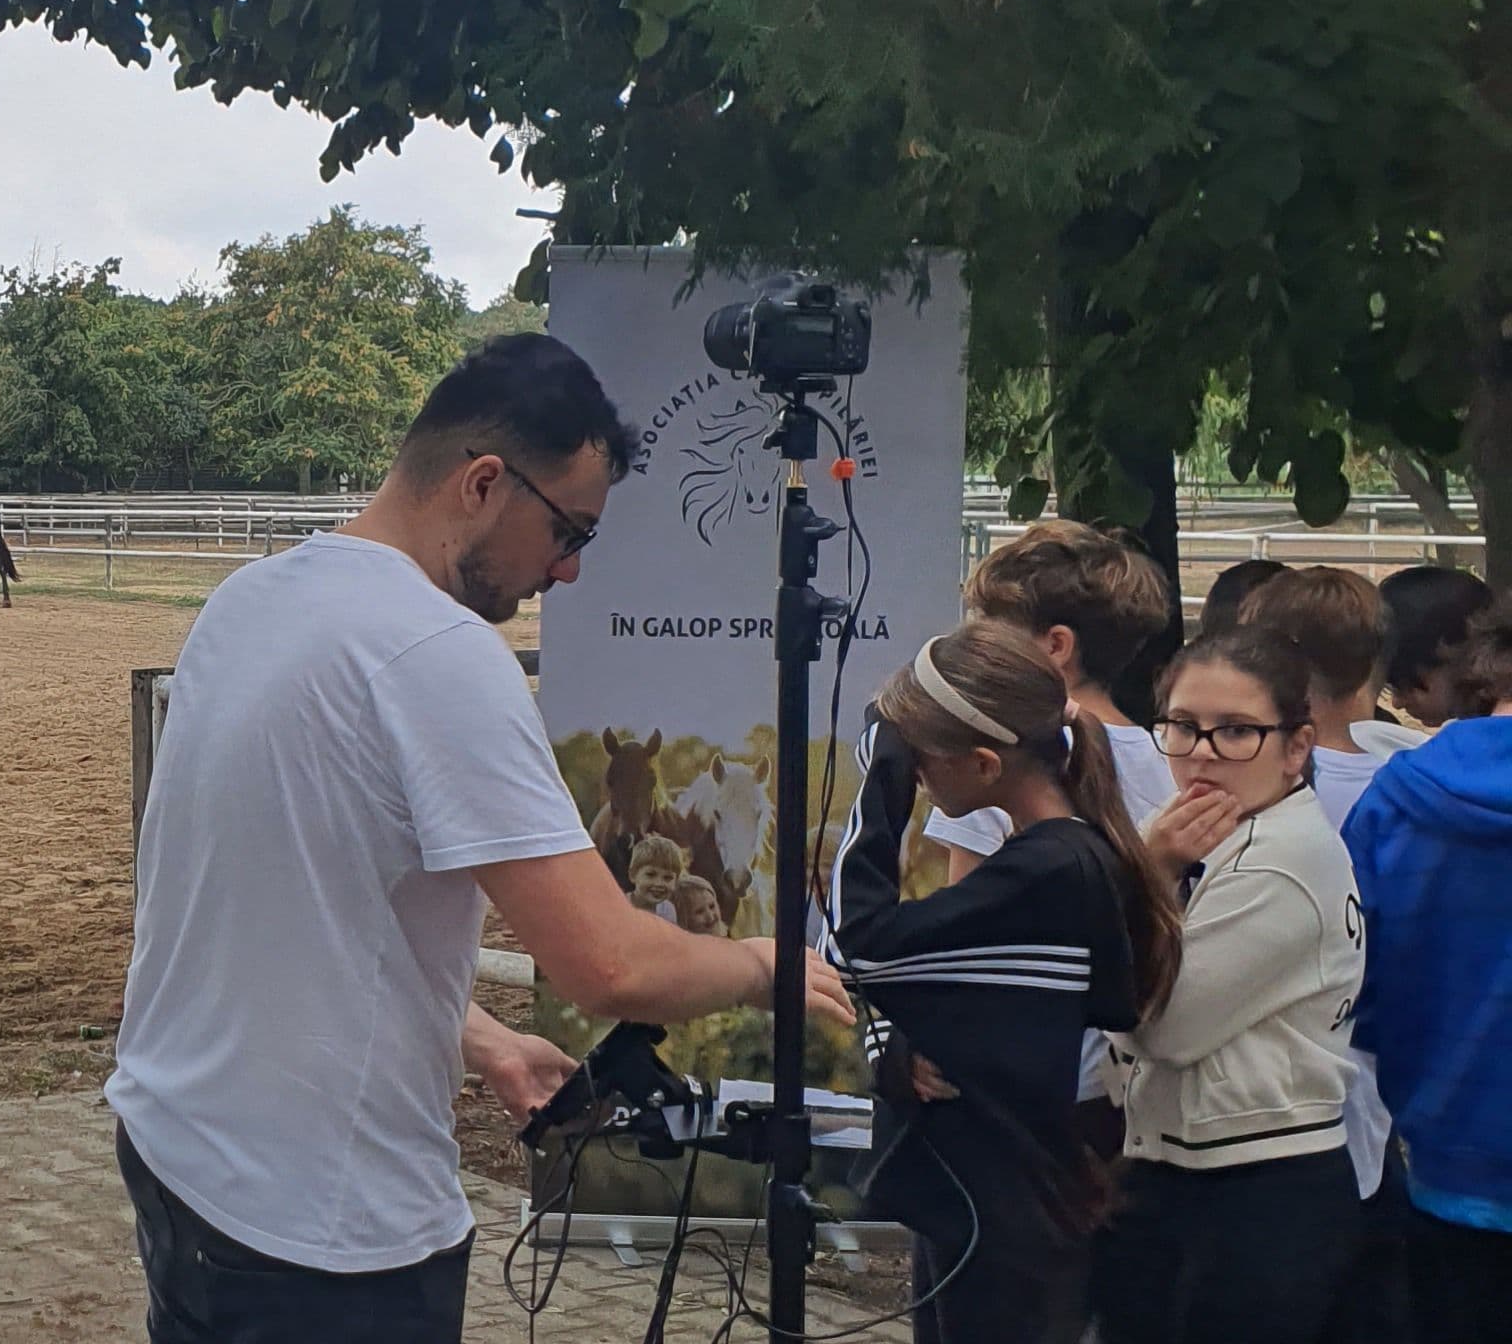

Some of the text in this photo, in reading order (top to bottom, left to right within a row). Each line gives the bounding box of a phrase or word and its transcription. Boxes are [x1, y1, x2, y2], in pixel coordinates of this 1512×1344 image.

[611, 613, 635, 637] ÎN
[642, 617, 722, 639] GALOP
[729, 617, 774, 639] SPR
